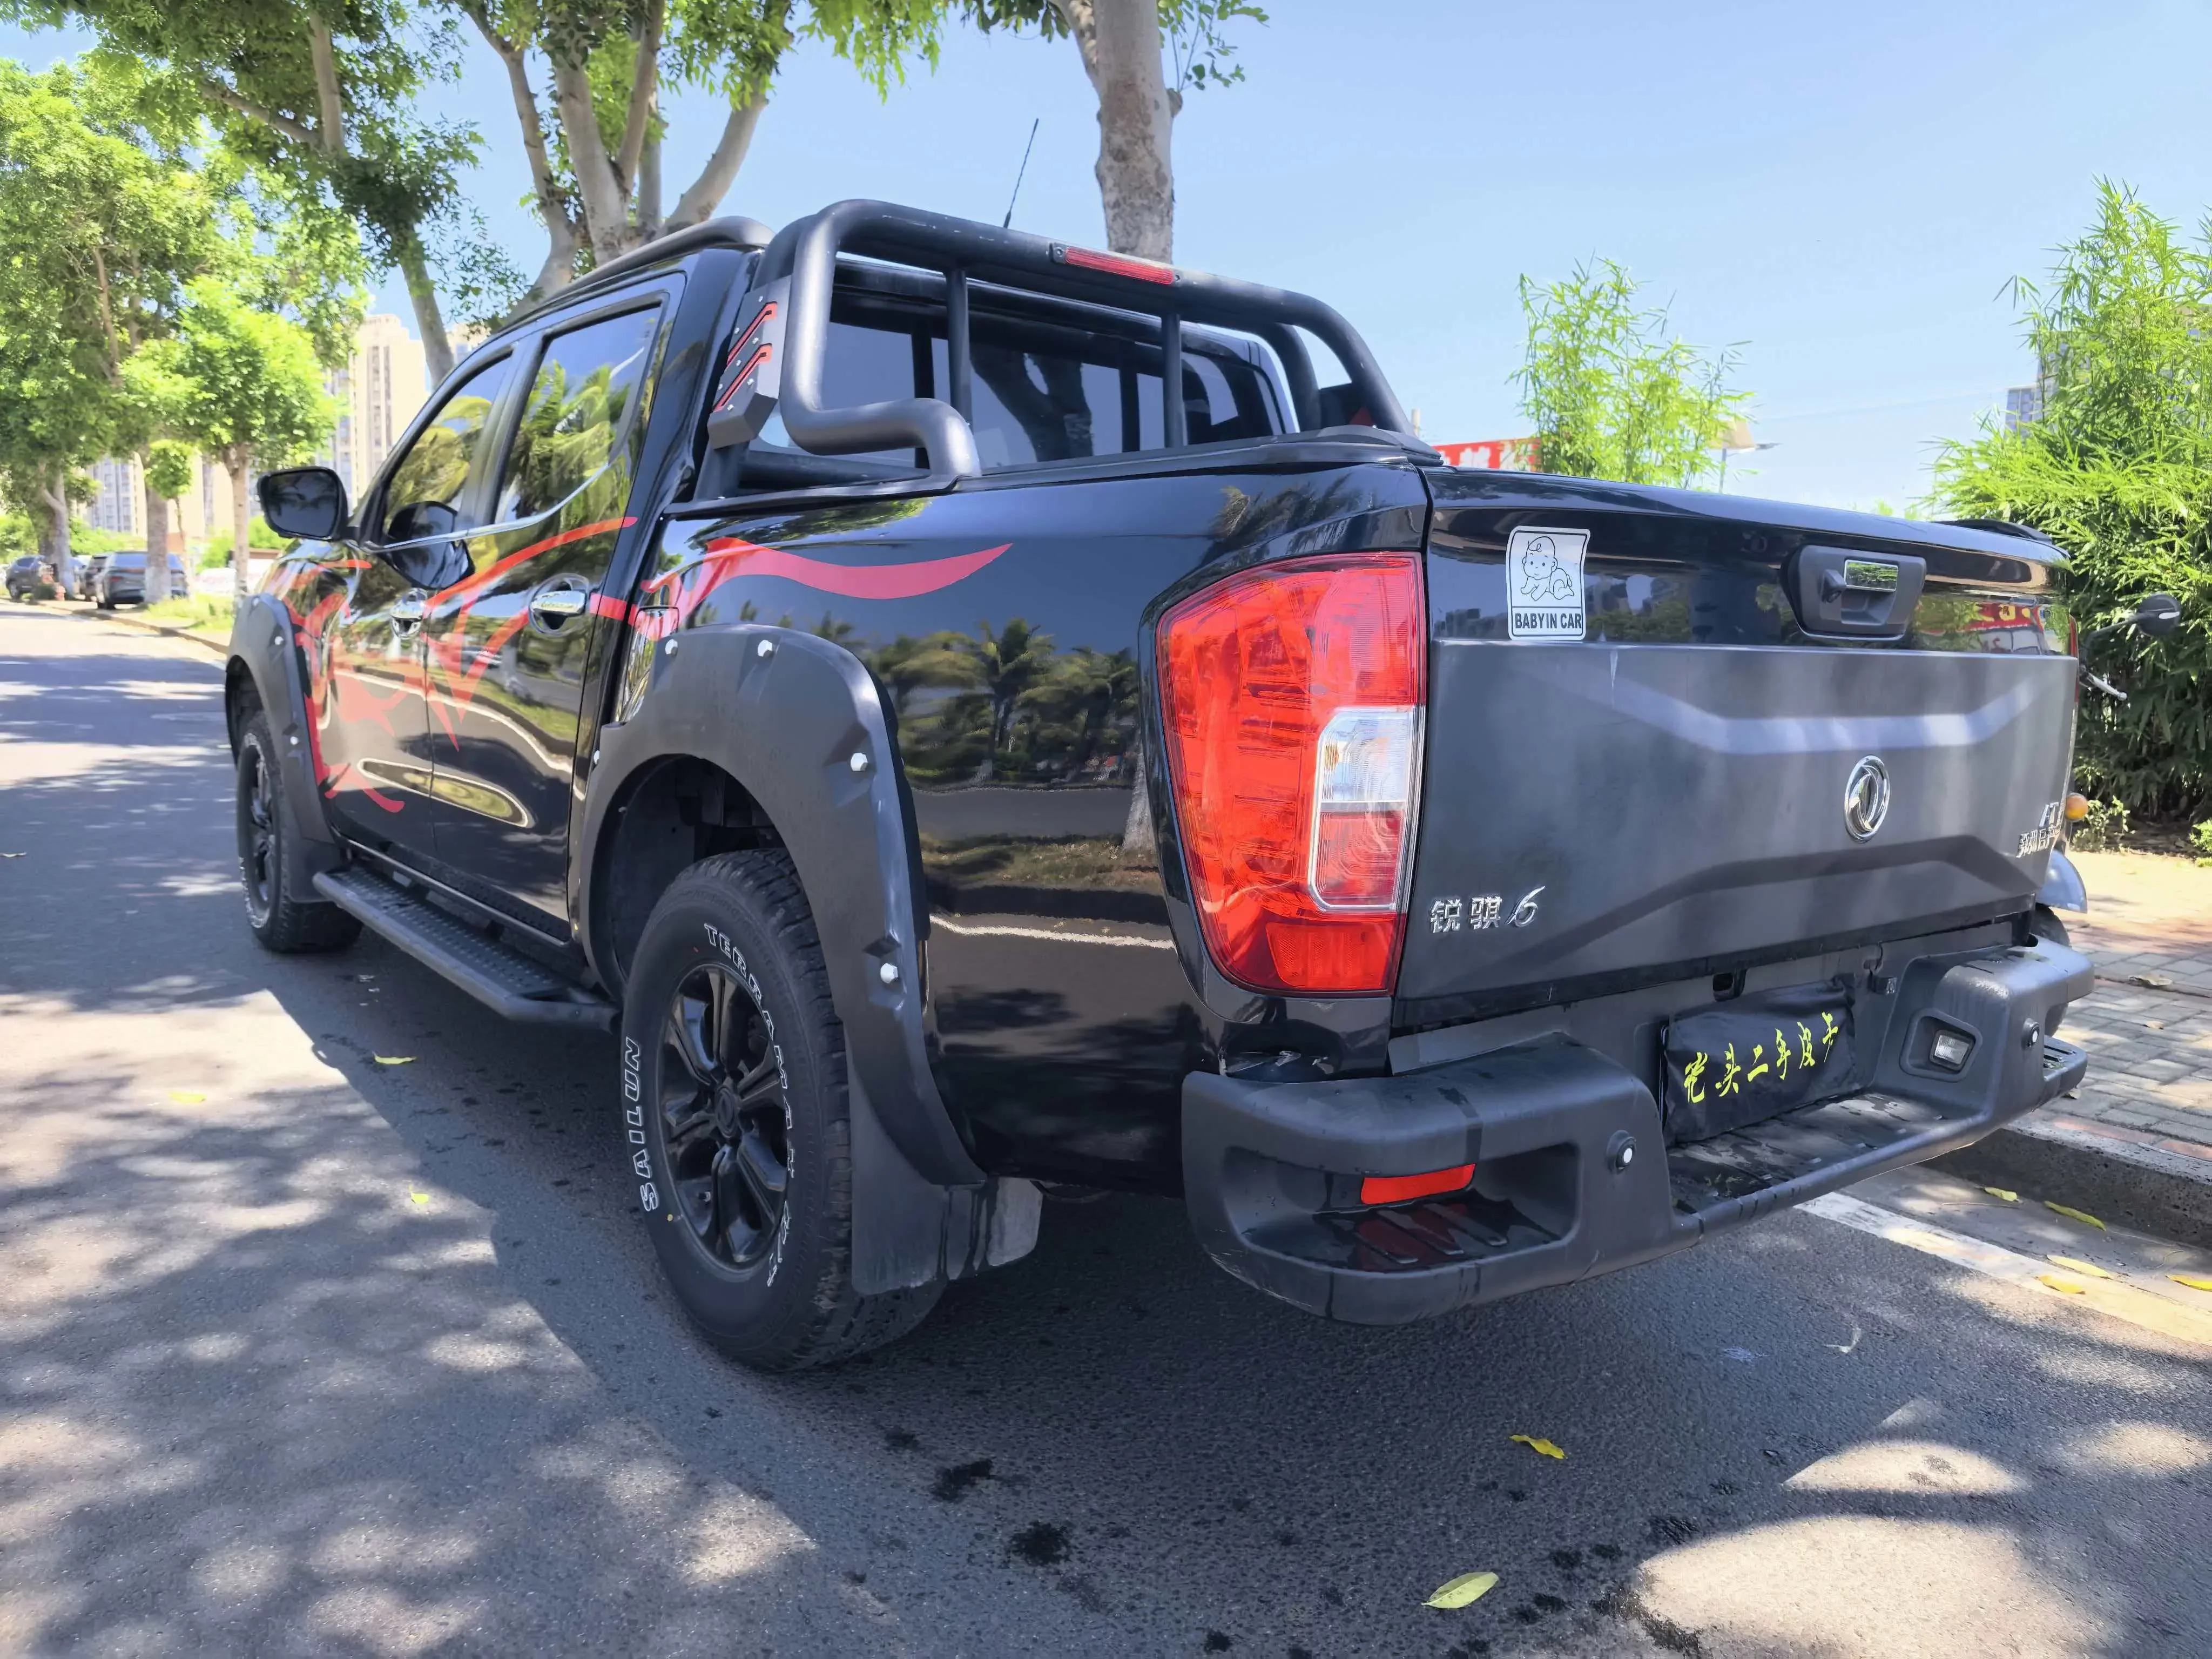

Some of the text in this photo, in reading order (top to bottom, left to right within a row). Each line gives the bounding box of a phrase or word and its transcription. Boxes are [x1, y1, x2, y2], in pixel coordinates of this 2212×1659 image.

[1560, 613, 1582, 629] CAR
[1429, 885, 1546, 933] 锐骐6
[624, 1036, 659, 1212] SAILUN
